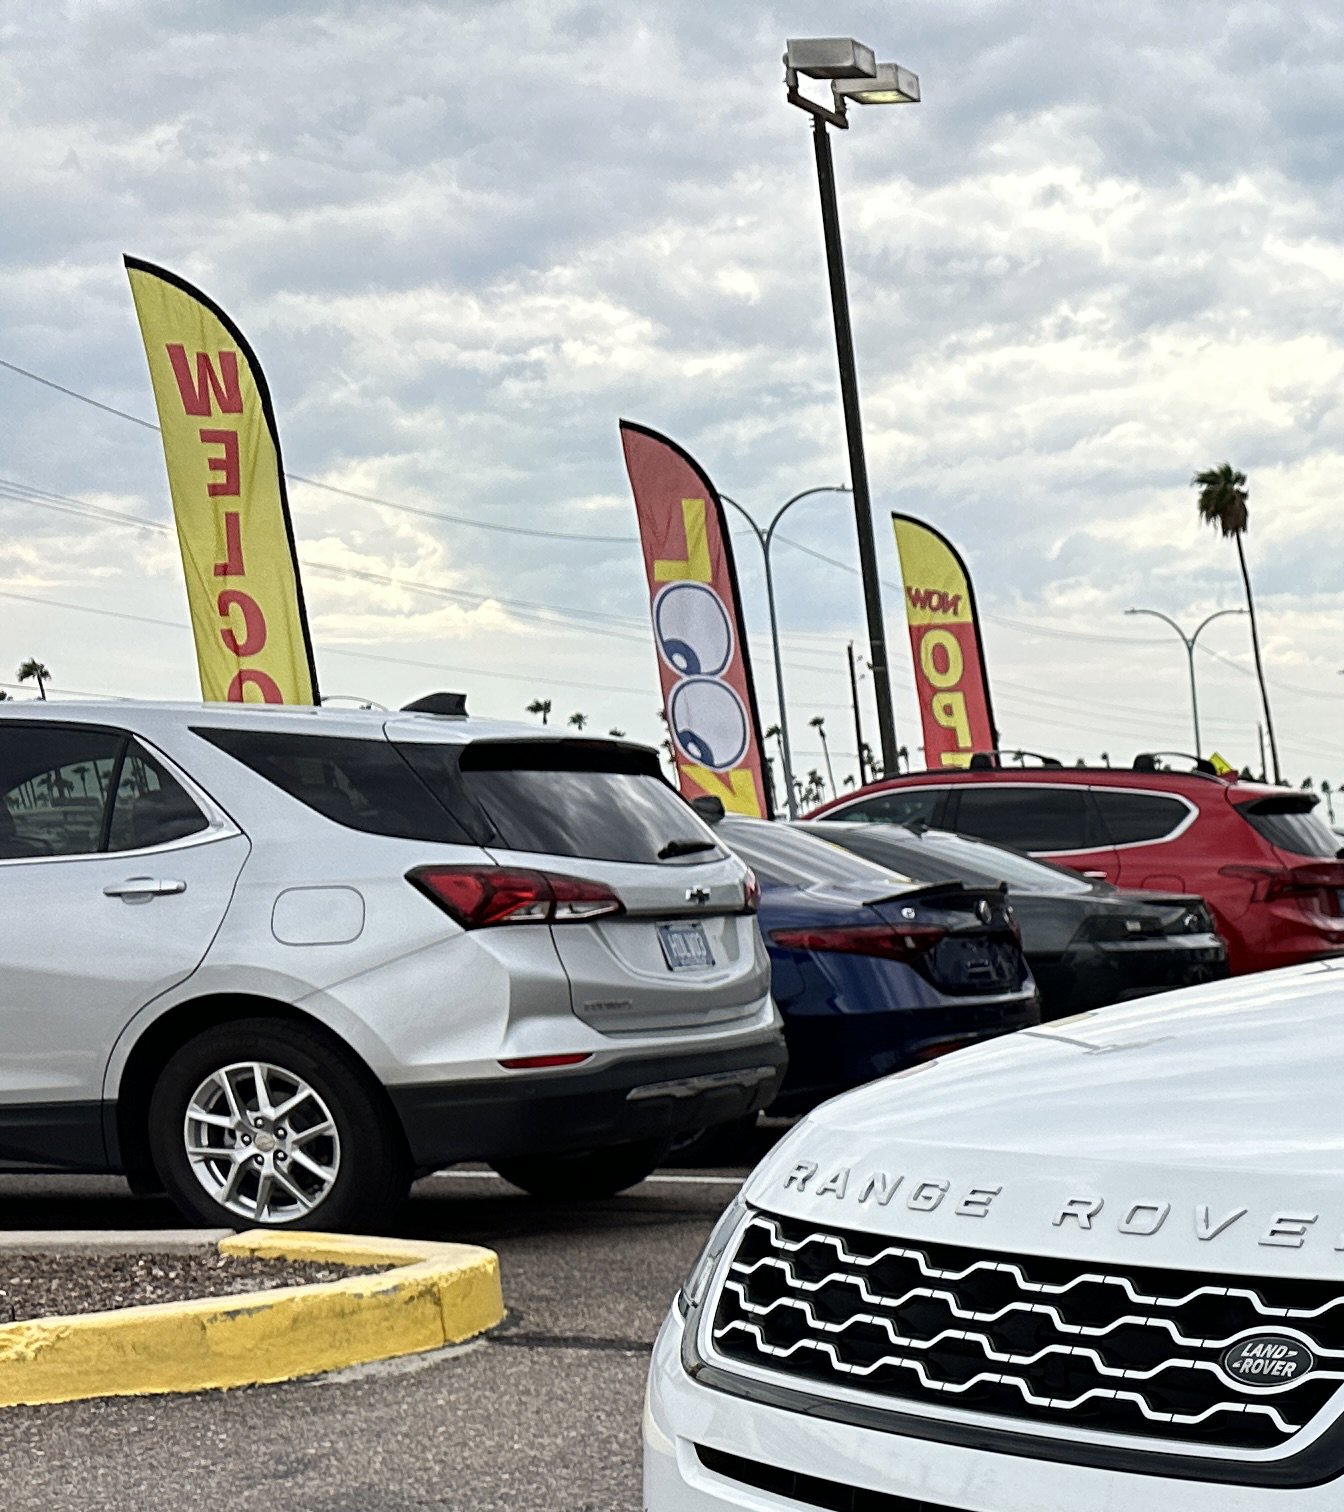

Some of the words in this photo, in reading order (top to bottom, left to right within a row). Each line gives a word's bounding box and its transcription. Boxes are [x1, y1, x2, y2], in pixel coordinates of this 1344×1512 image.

[783, 1159, 1002, 1217] RANGE
[1240, 1342, 1288, 1359] LAND
[1239, 1358, 1297, 1377] ROVER
